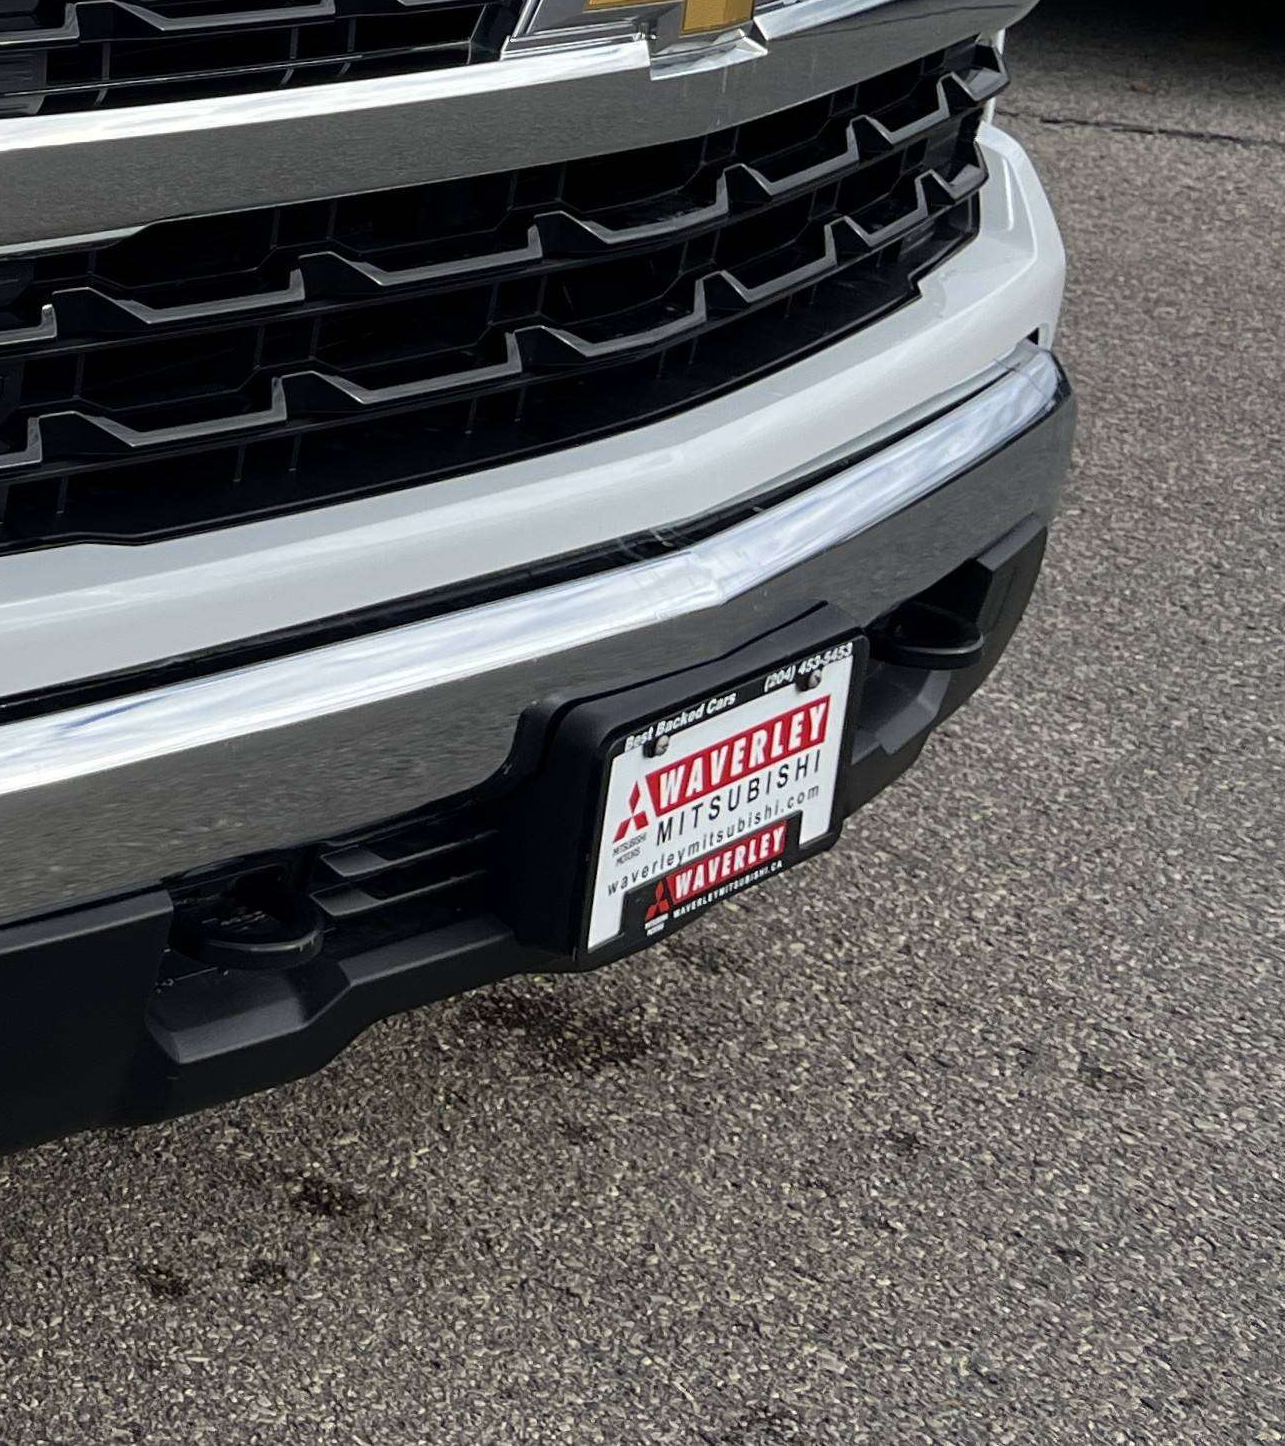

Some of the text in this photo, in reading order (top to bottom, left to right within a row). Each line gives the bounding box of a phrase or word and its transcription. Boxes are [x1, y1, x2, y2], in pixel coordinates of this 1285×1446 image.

[624, 692, 737, 752] Best Backed Cars
[764, 664, 796, 693] (204)
[657, 749, 820, 846] MITSUBISHI
[659, 702, 826, 810] WAVERLEY
[608, 785, 820, 896] waverleymitsubishi.com
[674, 824, 786, 901] WAVERLEY
